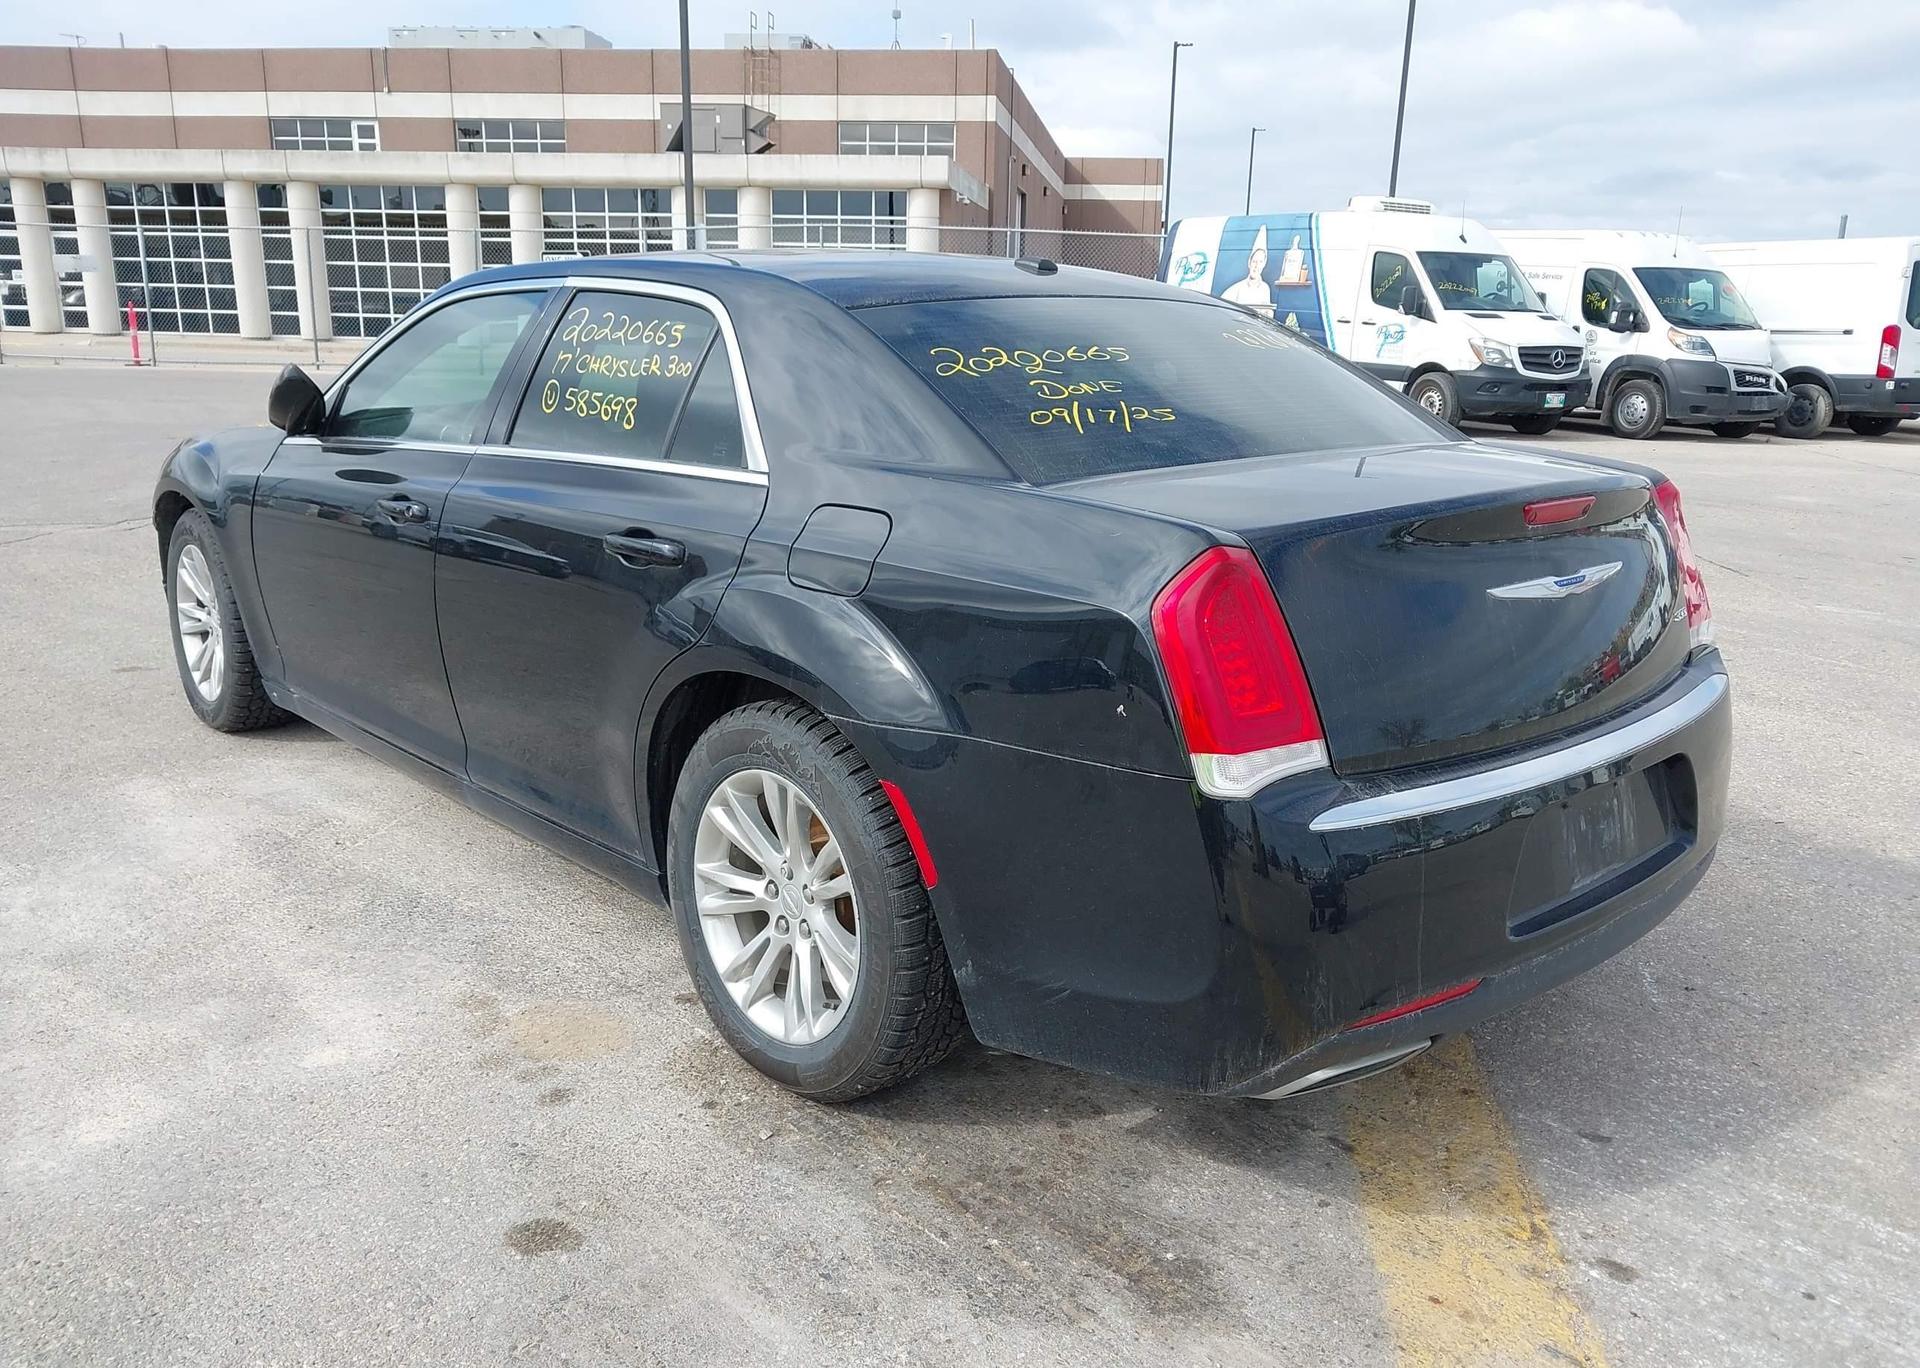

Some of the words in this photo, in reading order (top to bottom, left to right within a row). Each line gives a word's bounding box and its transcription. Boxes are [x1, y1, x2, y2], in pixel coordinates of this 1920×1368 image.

[563, 307, 686, 348] 20220665
[665, 355, 693, 378] 300
[1745, 375, 1766, 384] RAM
[1029, 379, 1122, 400] DONE
[564, 387, 638, 430] 585698
[1030, 400, 1177, 434] 09/17/25
